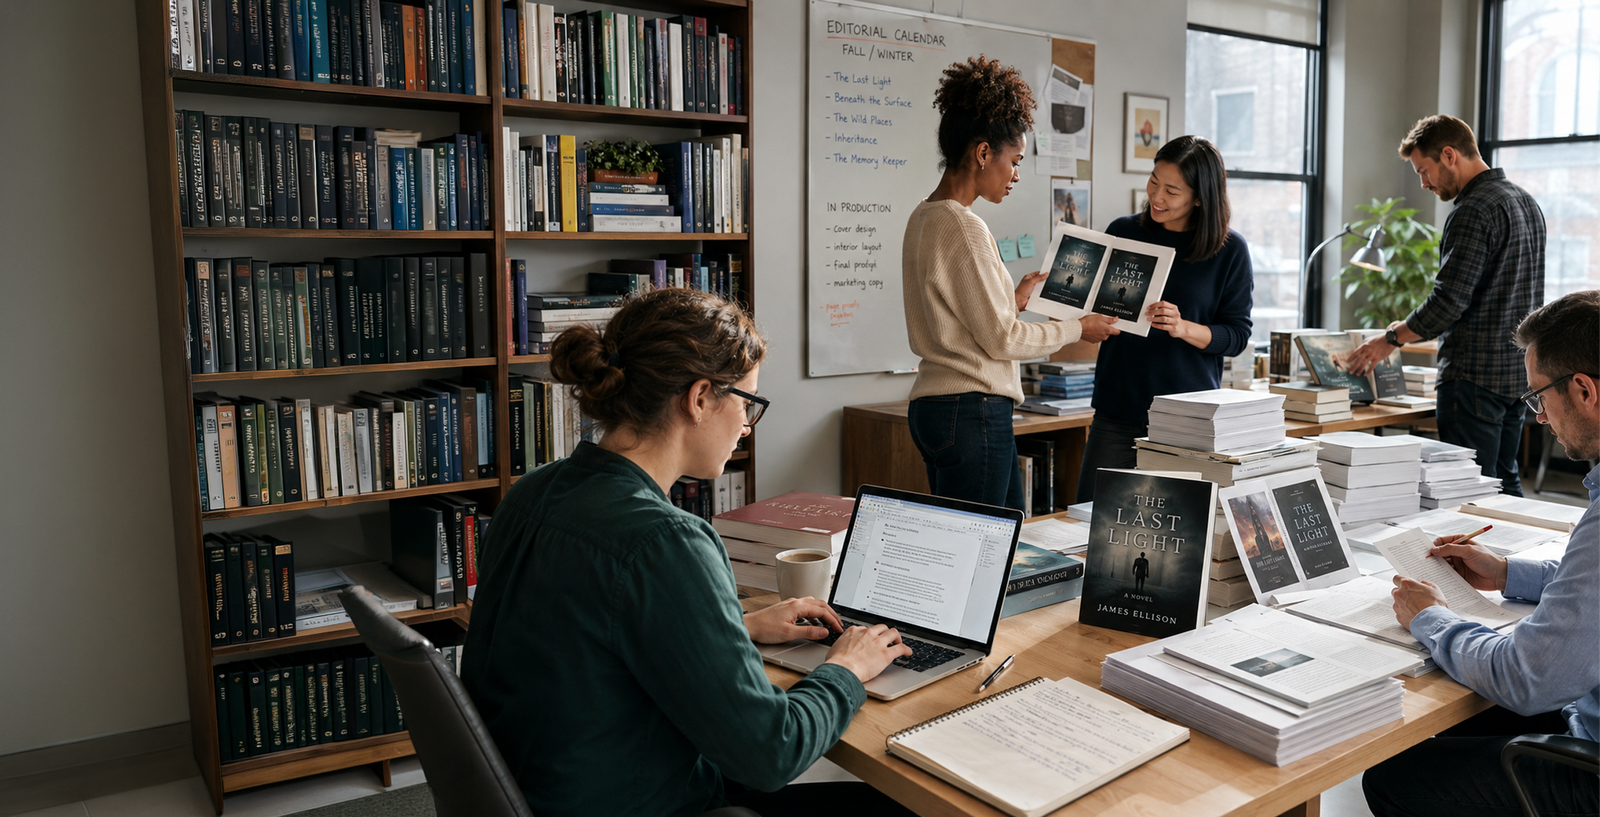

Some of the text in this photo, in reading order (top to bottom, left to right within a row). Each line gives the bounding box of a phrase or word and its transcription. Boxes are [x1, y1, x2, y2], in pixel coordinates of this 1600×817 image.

[827, 20, 946, 47] EDITORIAL CALENDAR
[842, 44, 865, 56] FALL
[877, 48, 914, 62] WINTER
[834, 72, 848, 82] The
[852, 74, 868, 84] Last
[872, 76, 892, 90] Light
[834, 92, 865, 104] Beneath
[869, 96, 881, 105] the
[884, 96, 912, 108] Surface
[834, 112, 848, 122] The
[851, 114, 867, 124] Wild
[870, 115, 892, 126] Places
[834, 132, 878, 144] Inheritance
[833, 153, 848, 163] The
[851, 154, 878, 169] Memory
[882, 156, 908, 169] Keeper
[827, 202, 891, 212] IN PRODUCTION
[856, 224, 876, 237] design
[834, 242, 858, 250] interior
[862, 242, 882, 255] layout
[834, 260, 850, 270] final
[1124, 261, 1140, 270] THE
[1115, 266, 1144, 279] LAST
[834, 278, 866, 290] marketing
[869, 279, 883, 290] copy
[1109, 276, 1144, 288] LIGHT
[1134, 494, 1166, 508] THE
[1293, 503, 1313, 516] THE
[1116, 508, 1181, 532] LAST
[1294, 513, 1321, 530] LAST
[1108, 528, 1186, 554] LIGHT
[1296, 526, 1328, 543] LIGHT
[1131, 594, 1153, 603] NOVEL
[1097, 604, 1177, 624] JAMES ELLISON
